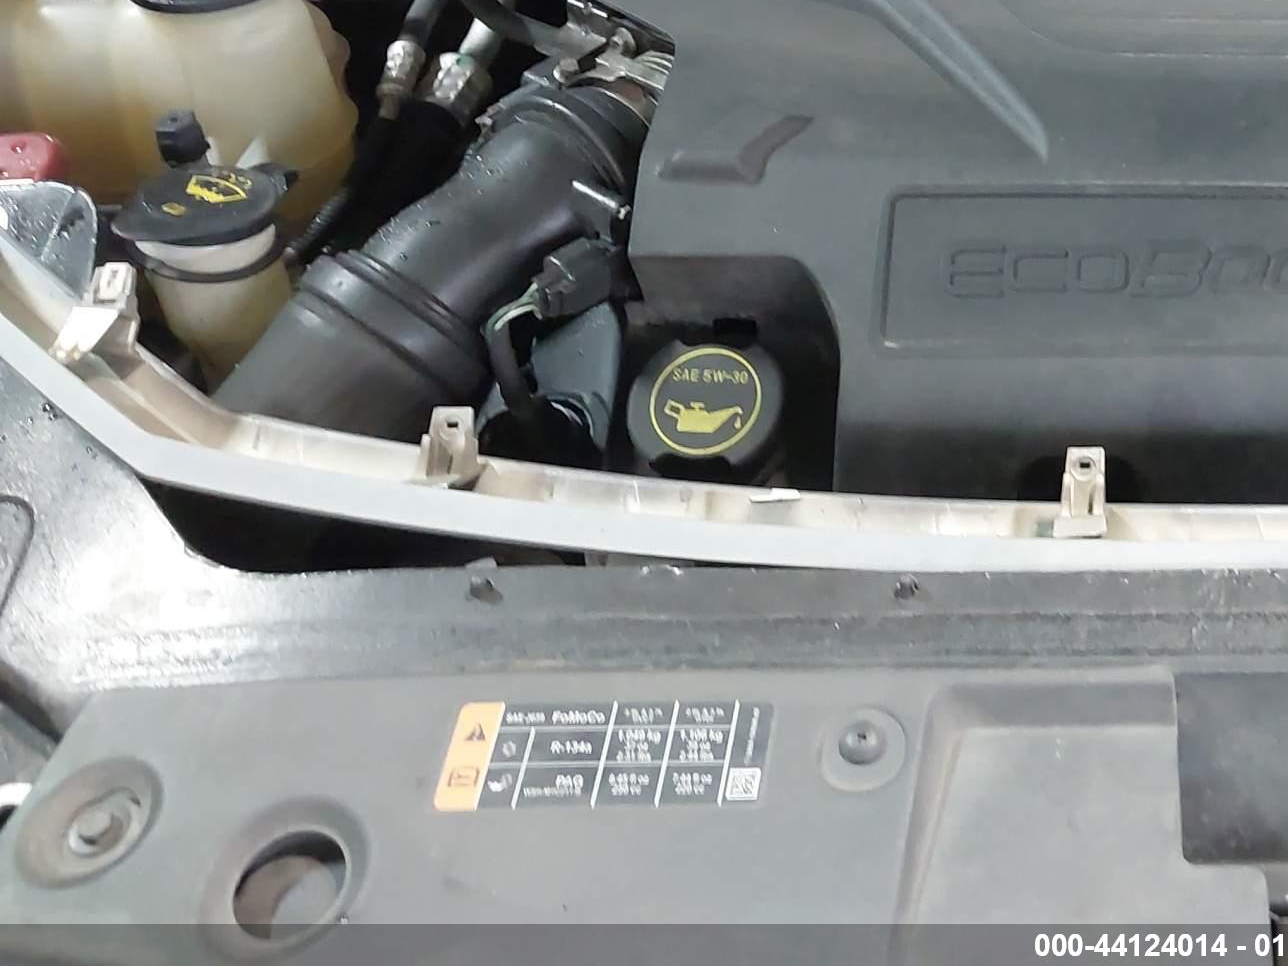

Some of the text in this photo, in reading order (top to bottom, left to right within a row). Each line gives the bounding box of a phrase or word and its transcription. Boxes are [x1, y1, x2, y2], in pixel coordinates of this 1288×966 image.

[672, 367, 749, 385] SAE 5W-30
[551, 709, 606, 725] FoMoCo
